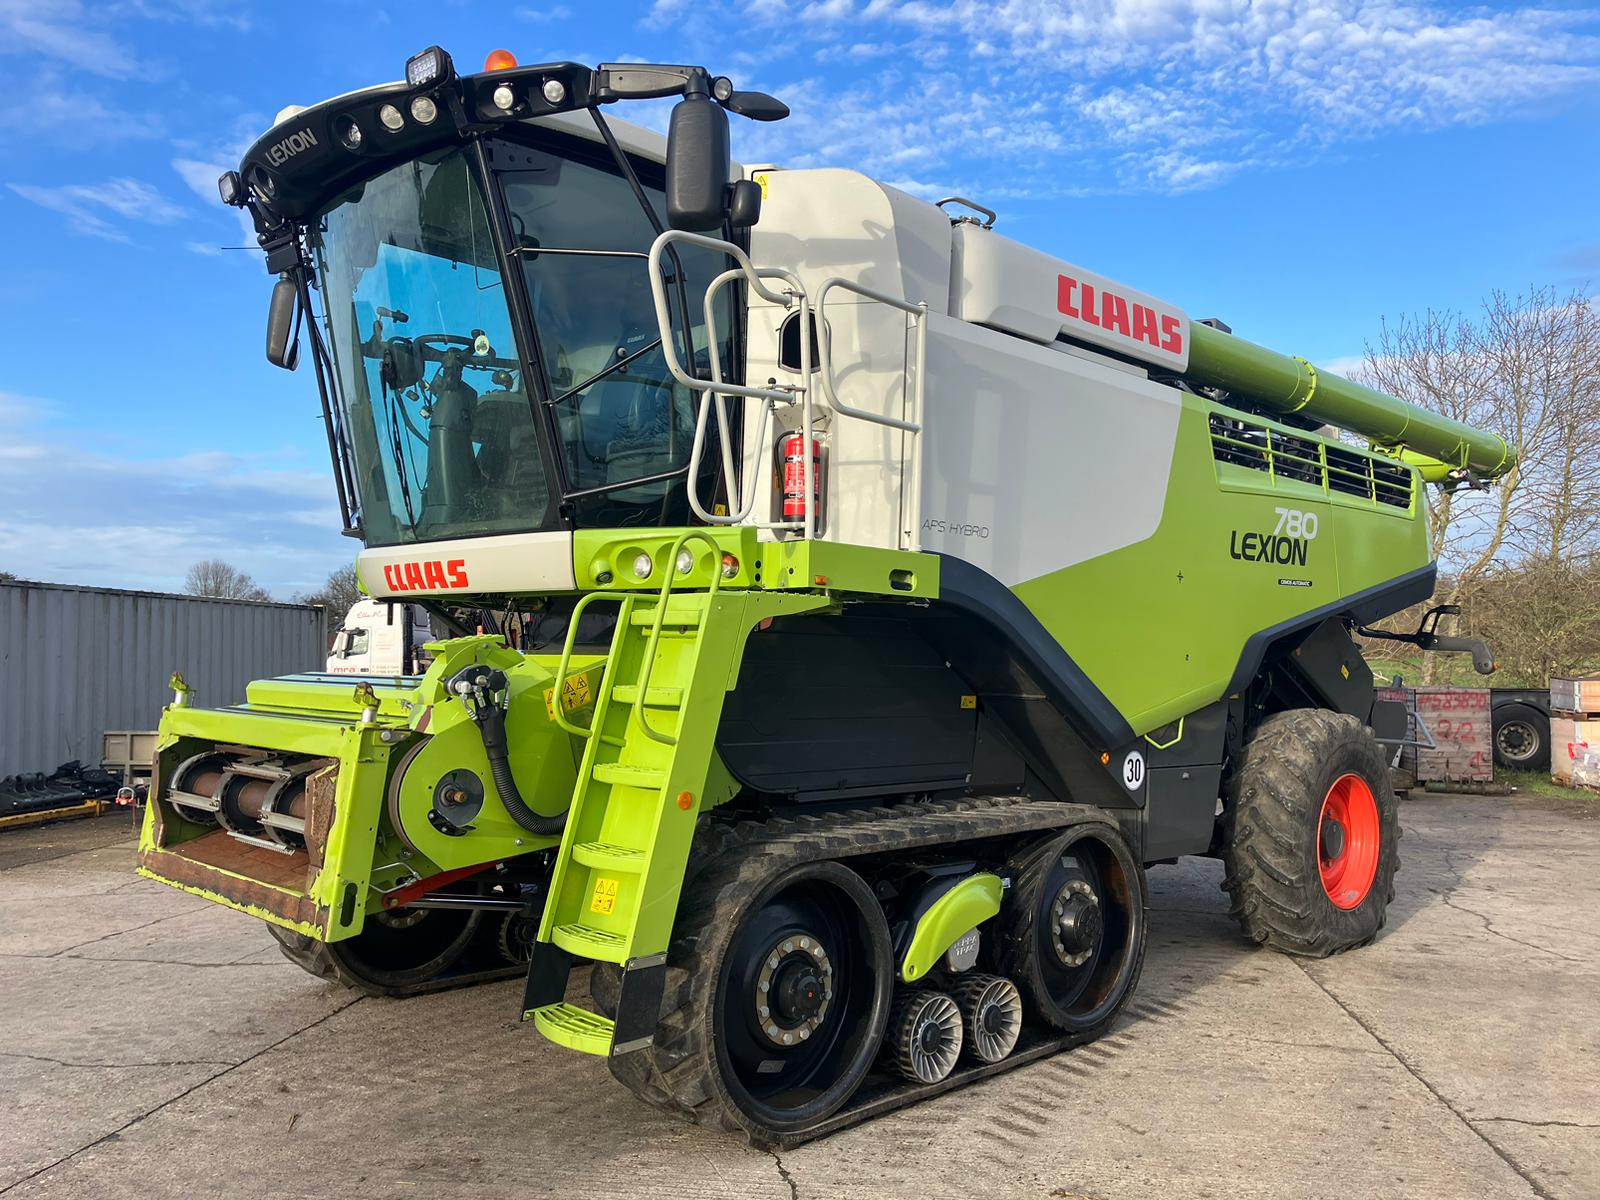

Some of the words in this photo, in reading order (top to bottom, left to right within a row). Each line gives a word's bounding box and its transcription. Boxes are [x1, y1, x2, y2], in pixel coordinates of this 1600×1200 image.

[265, 127, 318, 167] LEXION
[1057, 274, 1182, 355] CLAAS
[922, 519, 946, 533] APS
[949, 523, 989, 538] HYBRID
[1274, 507, 1318, 540] 780
[1230, 530, 1308, 566] LEXION
[384, 559, 469, 592] CLAAS
[1126, 758, 1141, 783] 30
